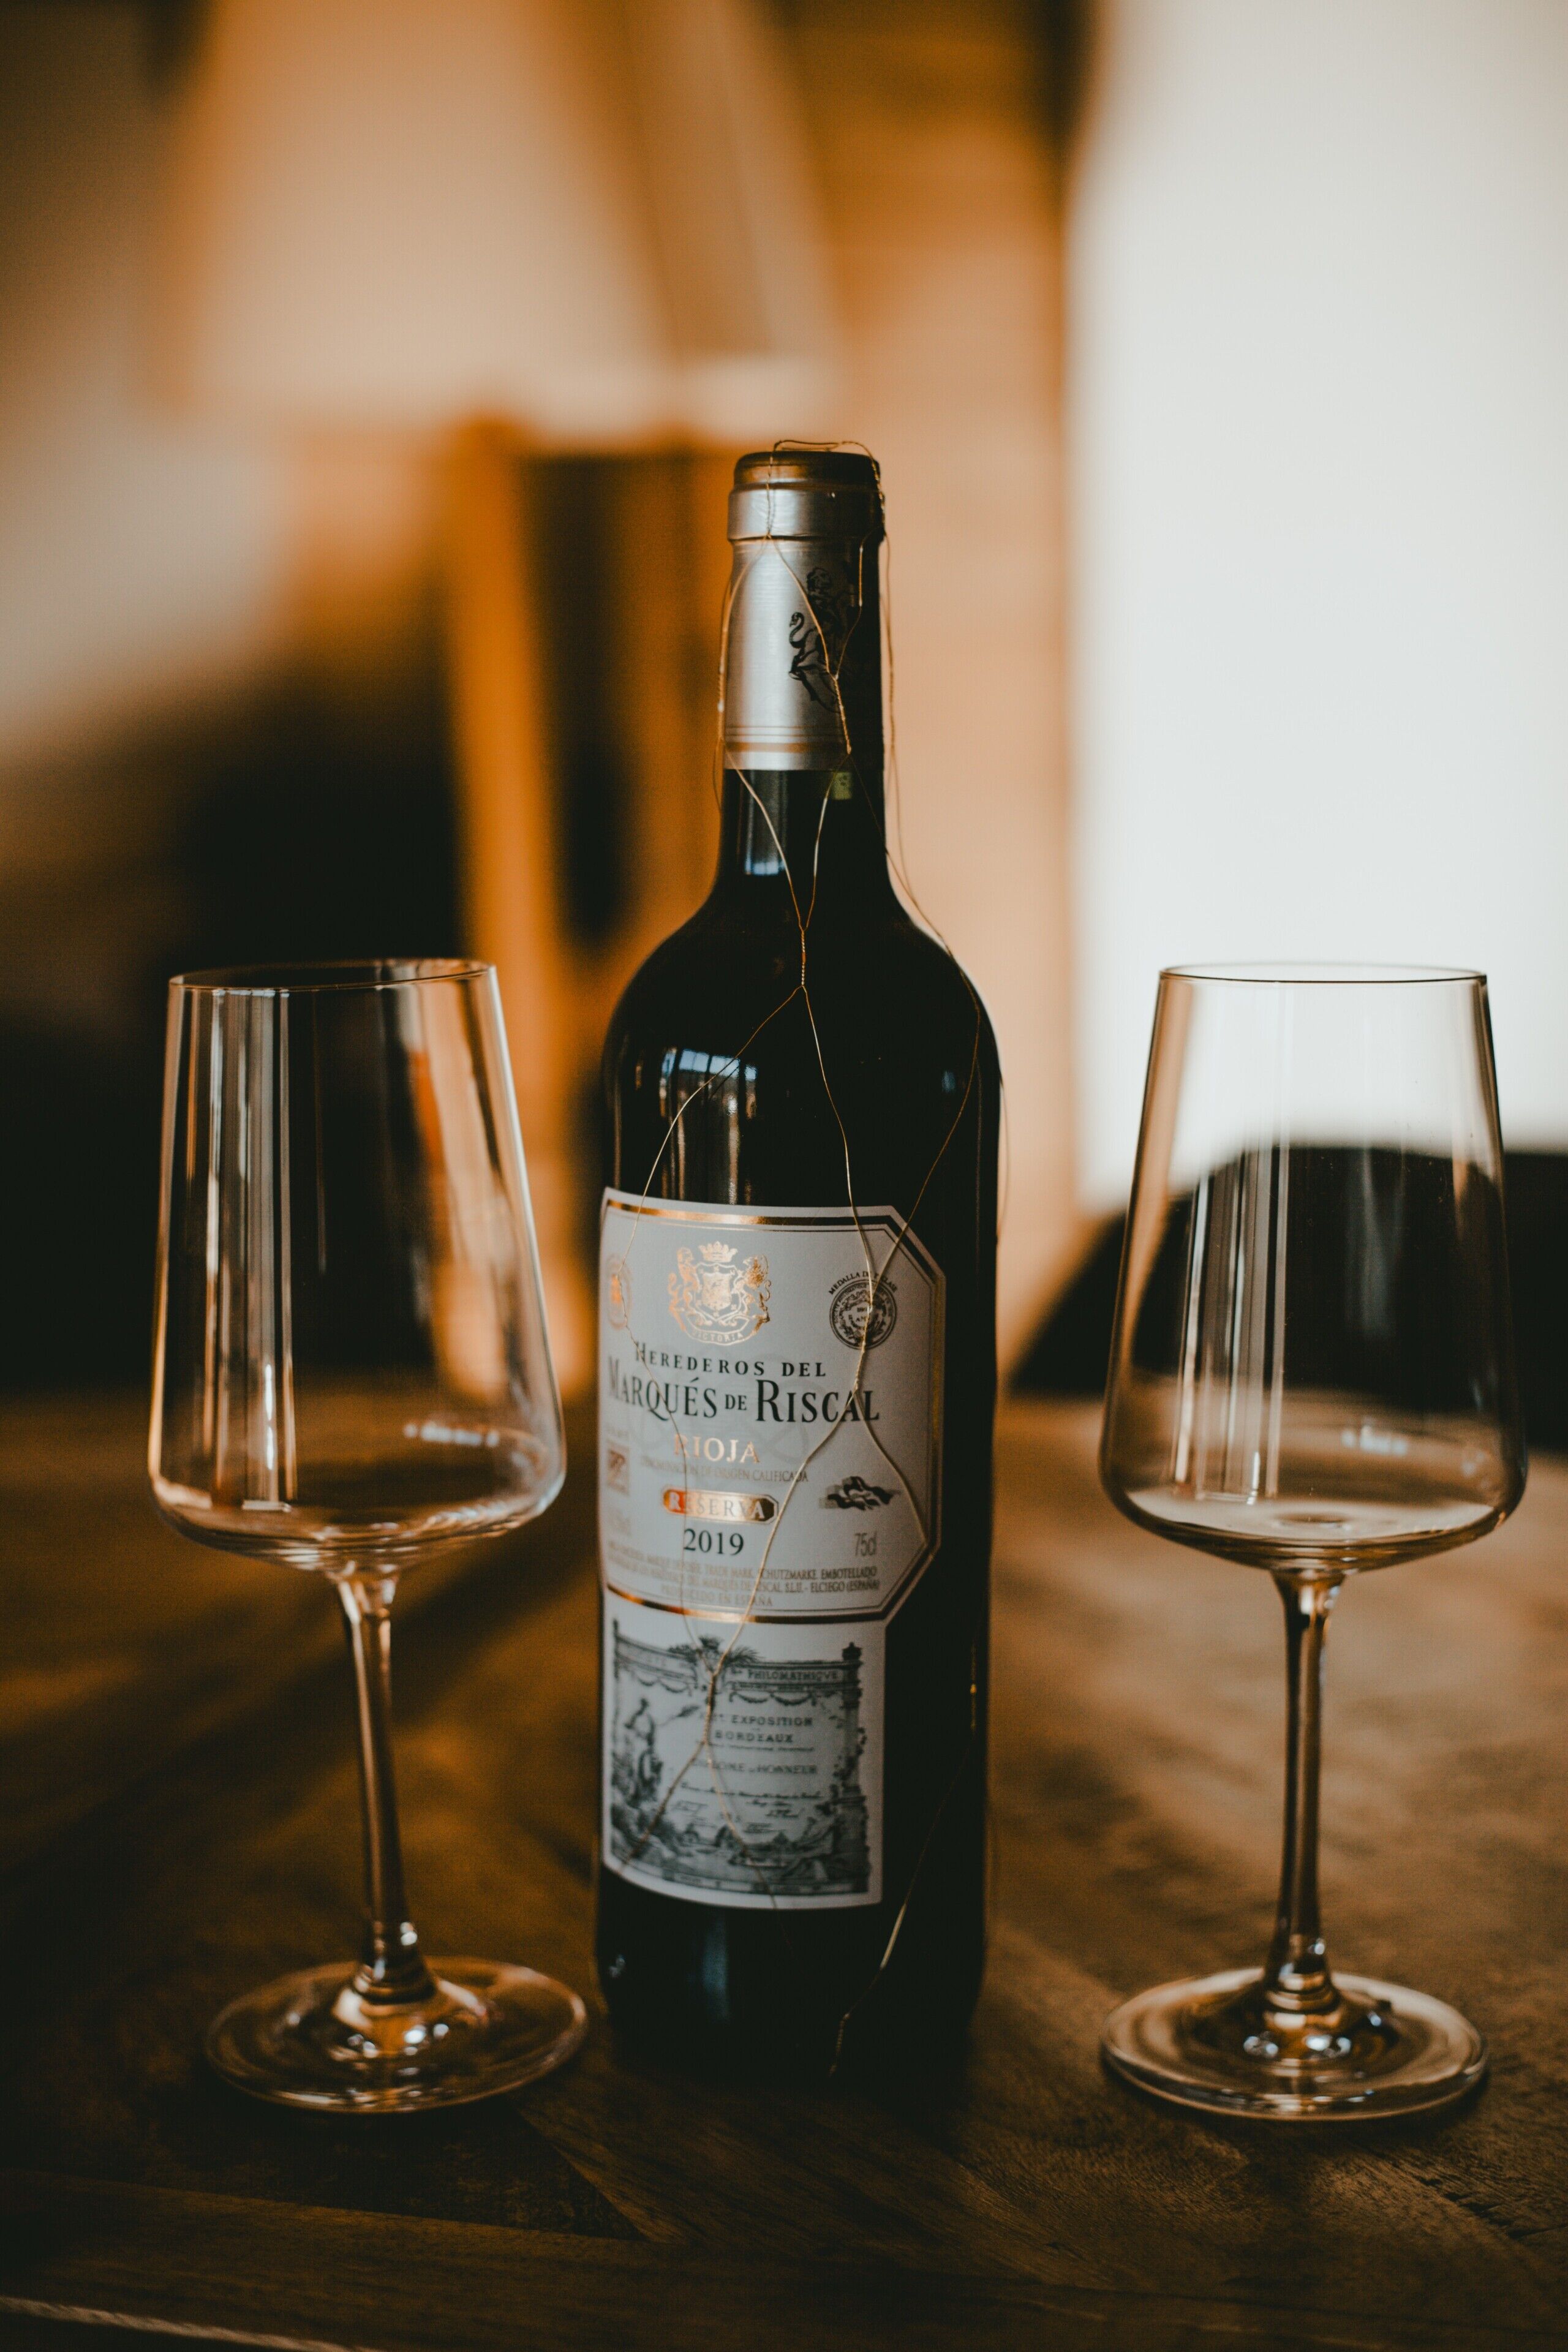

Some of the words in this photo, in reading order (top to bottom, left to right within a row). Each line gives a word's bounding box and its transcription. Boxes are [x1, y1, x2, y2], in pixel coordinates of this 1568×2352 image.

[829, 1272, 861, 1295] MEDALLA
[692, 1329, 744, 1343] VICTORIA
[635, 1341, 764, 1376] HEREDEROS
[782, 1362, 826, 1377] DEL
[608, 1355, 718, 1422] MARQUÉS
[725, 1394, 747, 1411] DE
[756, 1379, 880, 1423] RISCAL
[674, 1433, 761, 1463] RIOJA
[668, 1490, 766, 1520] RESERVA
[684, 1528, 745, 1556] 2019
[731, 1715, 813, 1727] EXPOSITION
[715, 1730, 793, 1743] BORDEAUX
